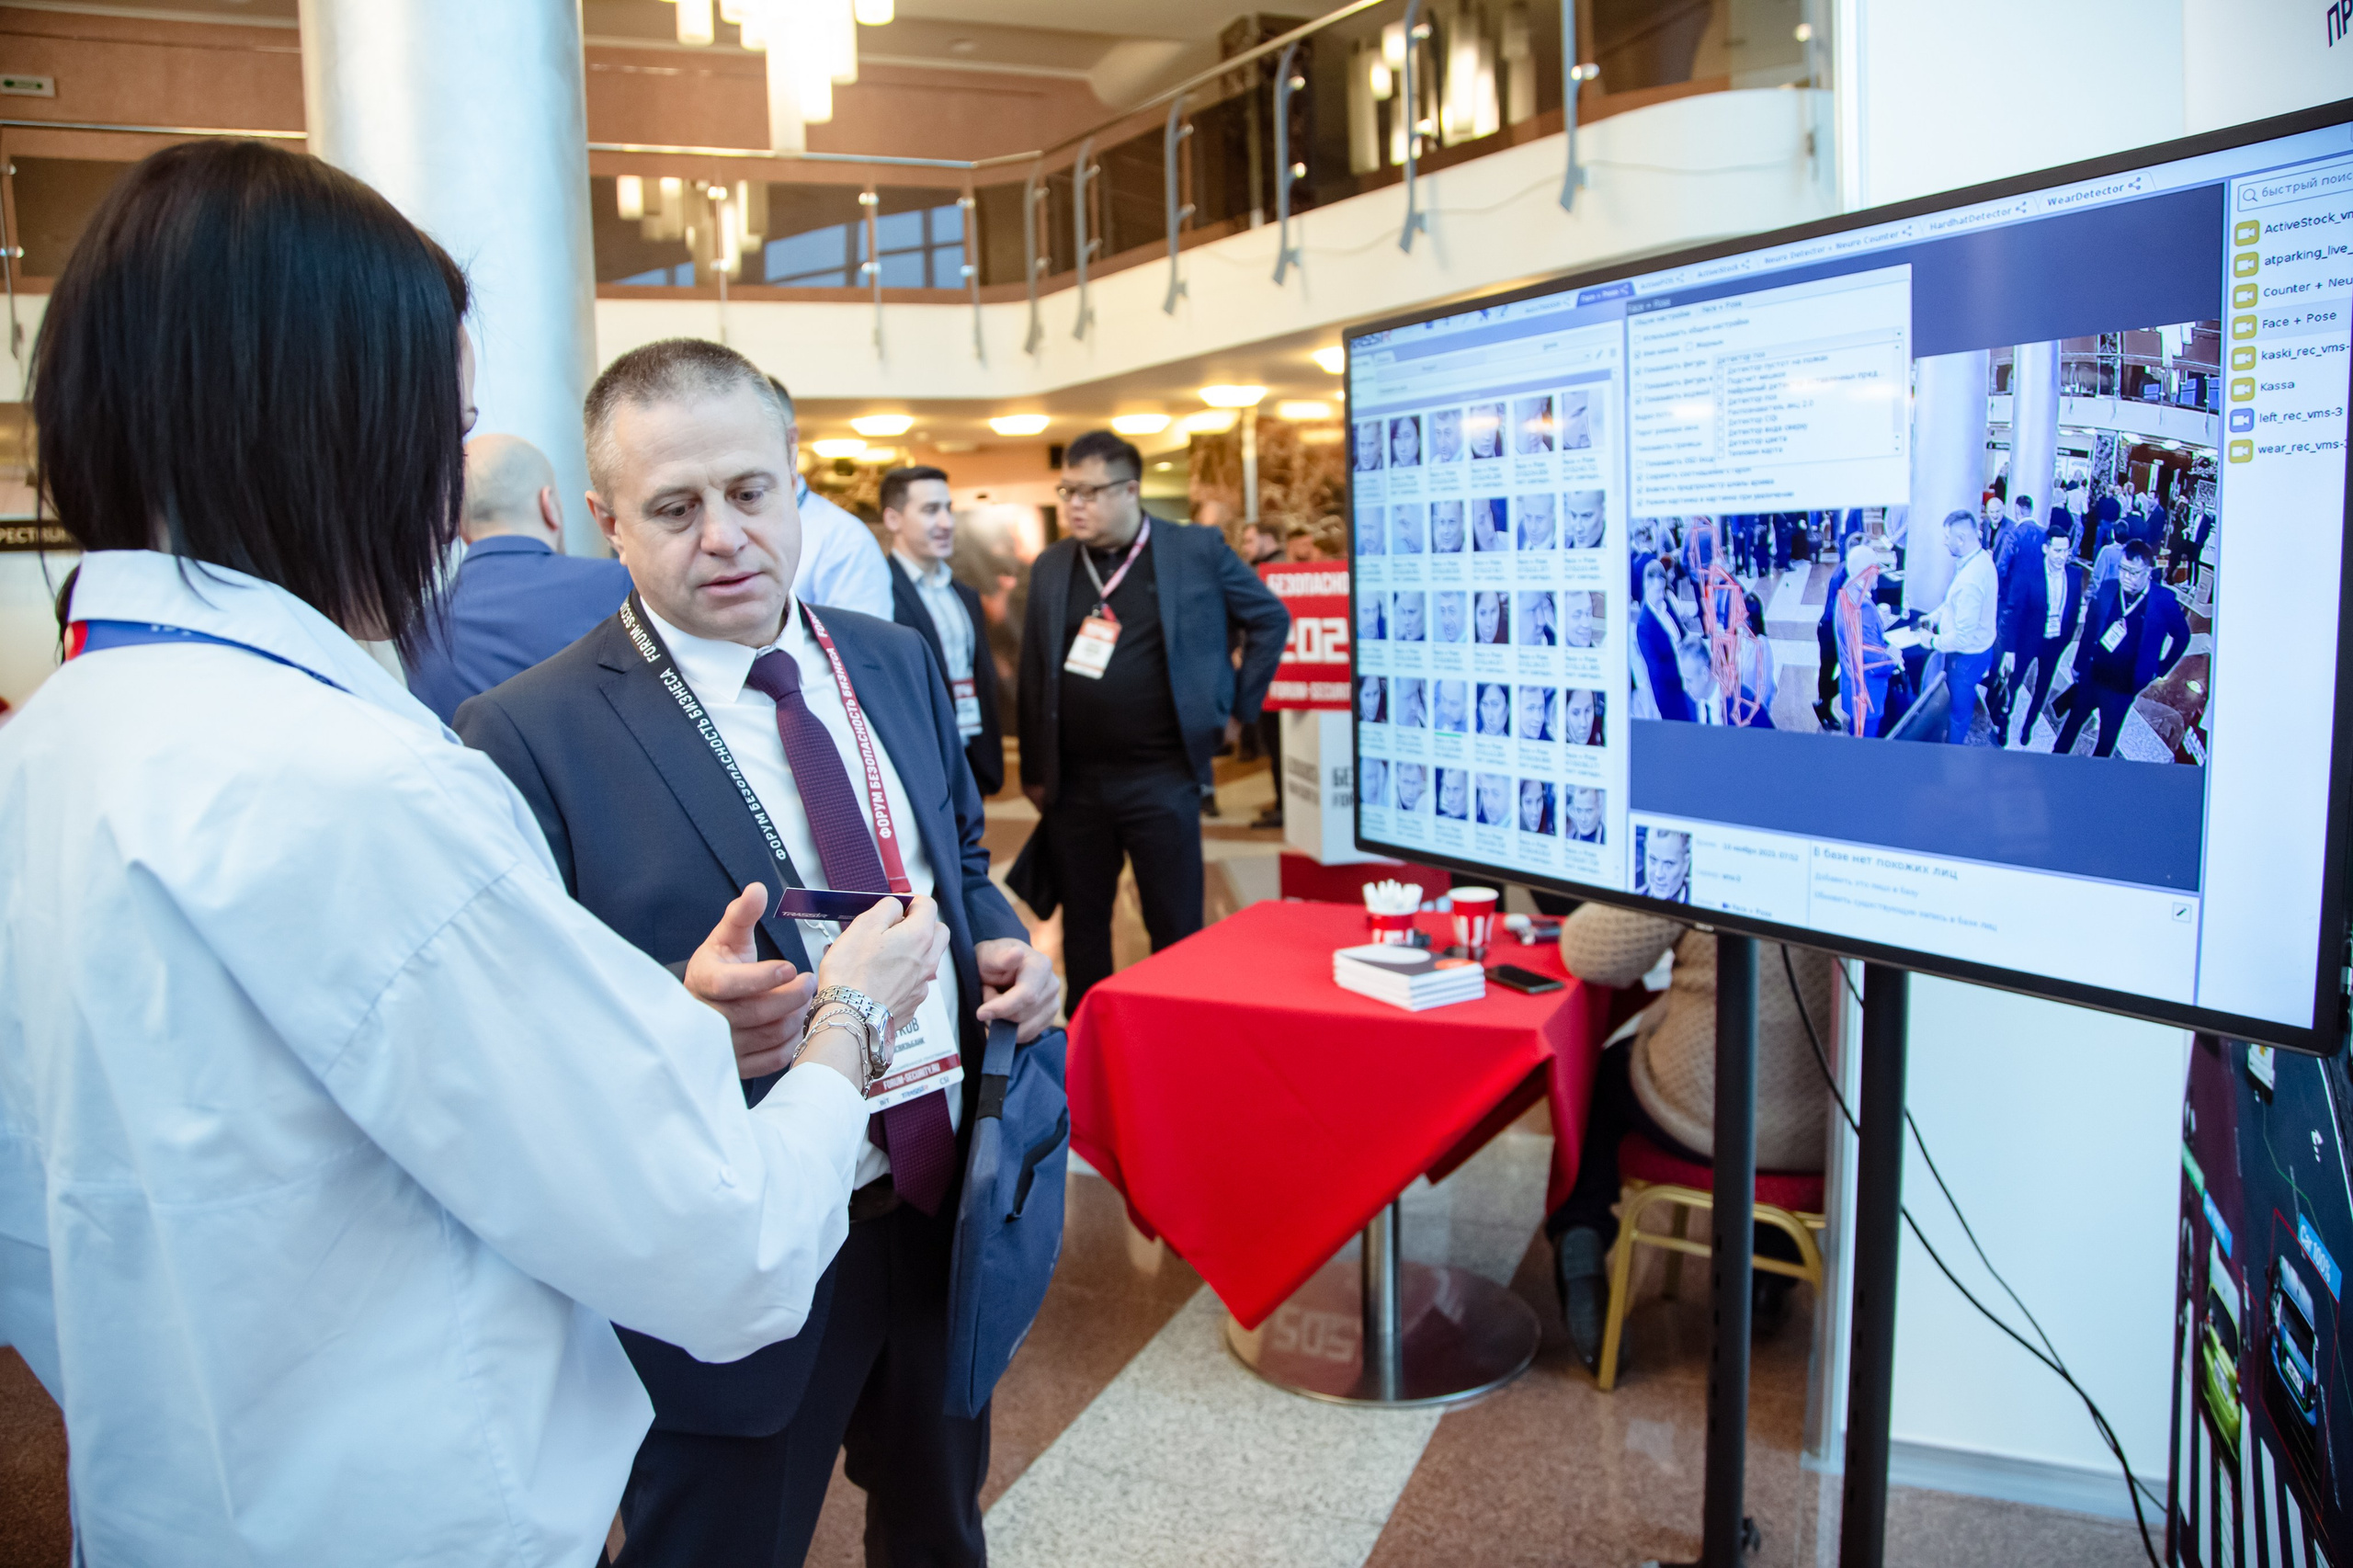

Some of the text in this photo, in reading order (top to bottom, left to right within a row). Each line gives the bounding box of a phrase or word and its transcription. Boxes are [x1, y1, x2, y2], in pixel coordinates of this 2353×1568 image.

[2047, 183, 2124, 207] WearDetector
[2262, 177, 2318, 198] быстрый
[1929, 207, 2012, 231] HardhatDetector
[2263, 282, 2312, 297] Counter
[2262, 317, 2290, 329] Face
[2306, 312, 2337, 323] Pose
[2260, 381, 2296, 392] Kassa
[2259, 407, 2344, 424] left_rec_vms-3
[659, 667, 703, 720] БИЗНЕСА
[826, 647, 892, 838] ФОРУМ БЕЗОПАСНОСТЬ БИЗНЕСА
[697, 718, 761, 812] БЕЗОПАСНОСТЬ
[754, 812, 787, 860] ФОРУМ
[1813, 846, 1959, 881] В базе нет похожих лиц
[781, 911, 829, 919] TRASSIR
